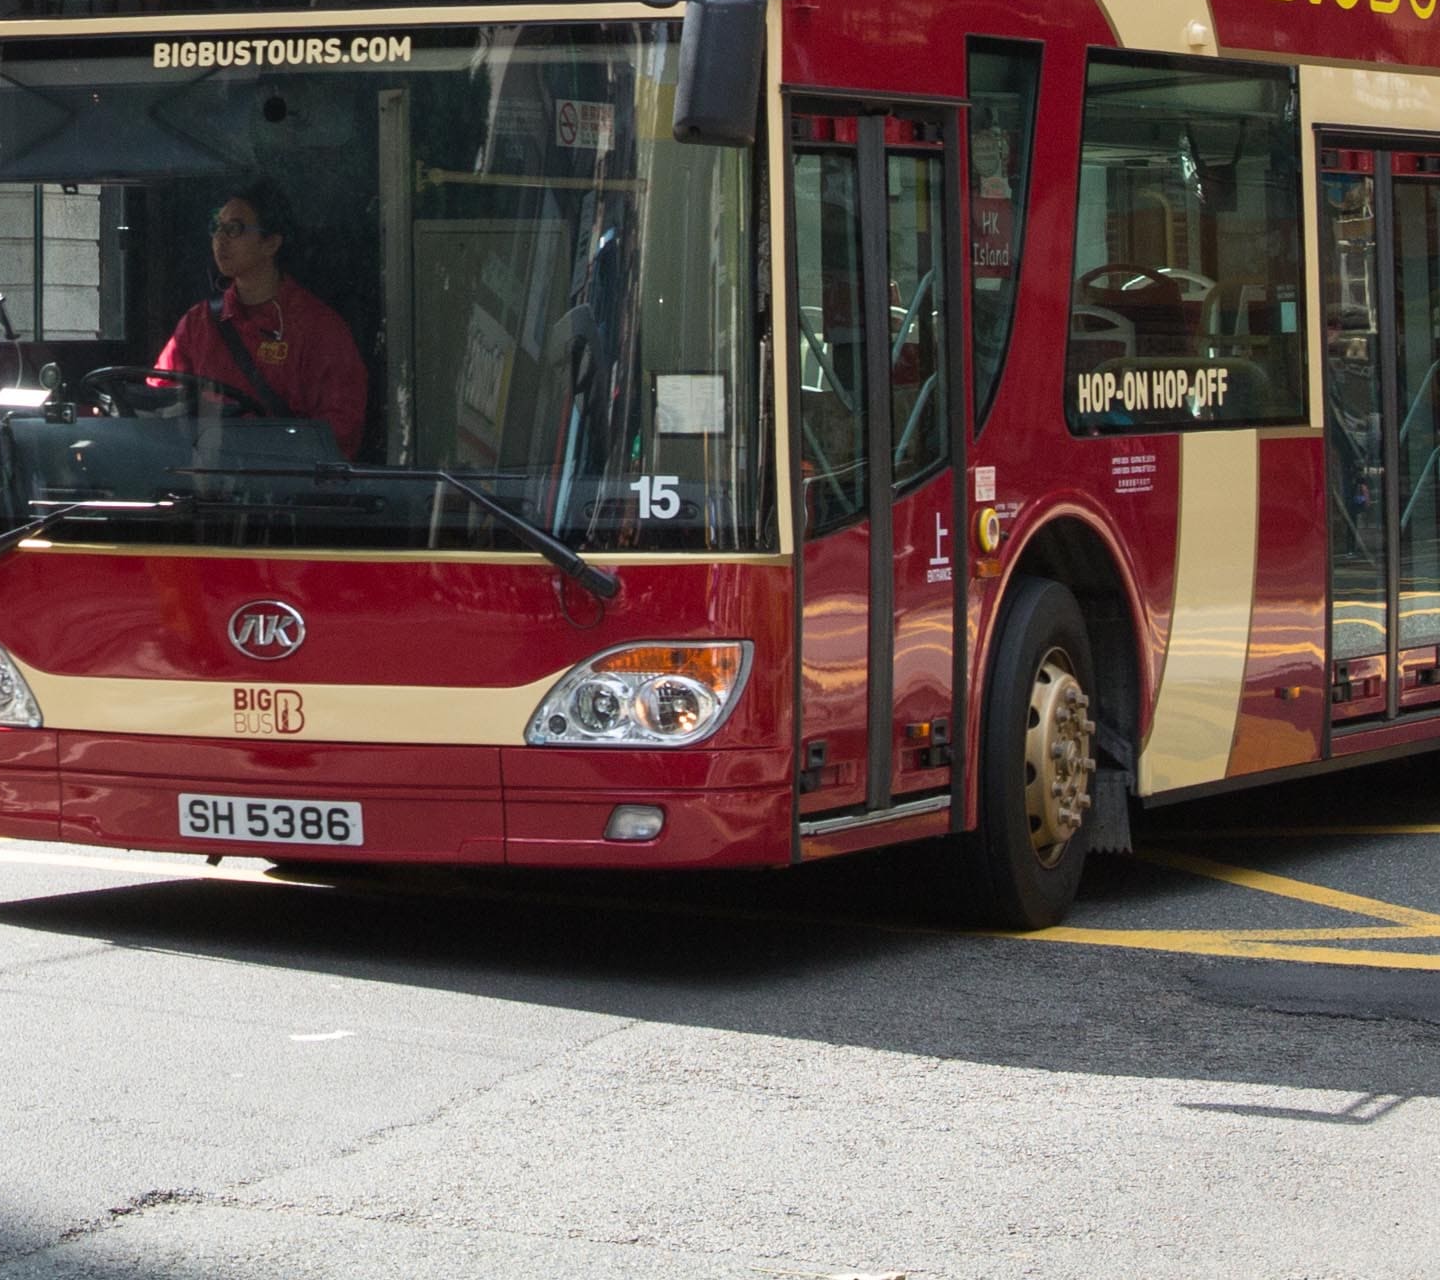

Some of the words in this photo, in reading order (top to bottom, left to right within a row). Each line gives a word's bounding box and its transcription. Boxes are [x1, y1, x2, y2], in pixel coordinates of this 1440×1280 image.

[152, 36, 412, 69] BIGBUSTOURS.COM
[981, 211, 1001, 235] HK
[972, 242, 1009, 267] Island
[1078, 371, 1148, 414] HOP-ON
[1153, 367, 1229, 411] HOP-OFF
[630, 476, 681, 519] 15
[234, 688, 271, 711] BIG
[234, 713, 273, 734] BUS
[188, 799, 236, 835] SH
[246, 803, 350, 842] 5386
